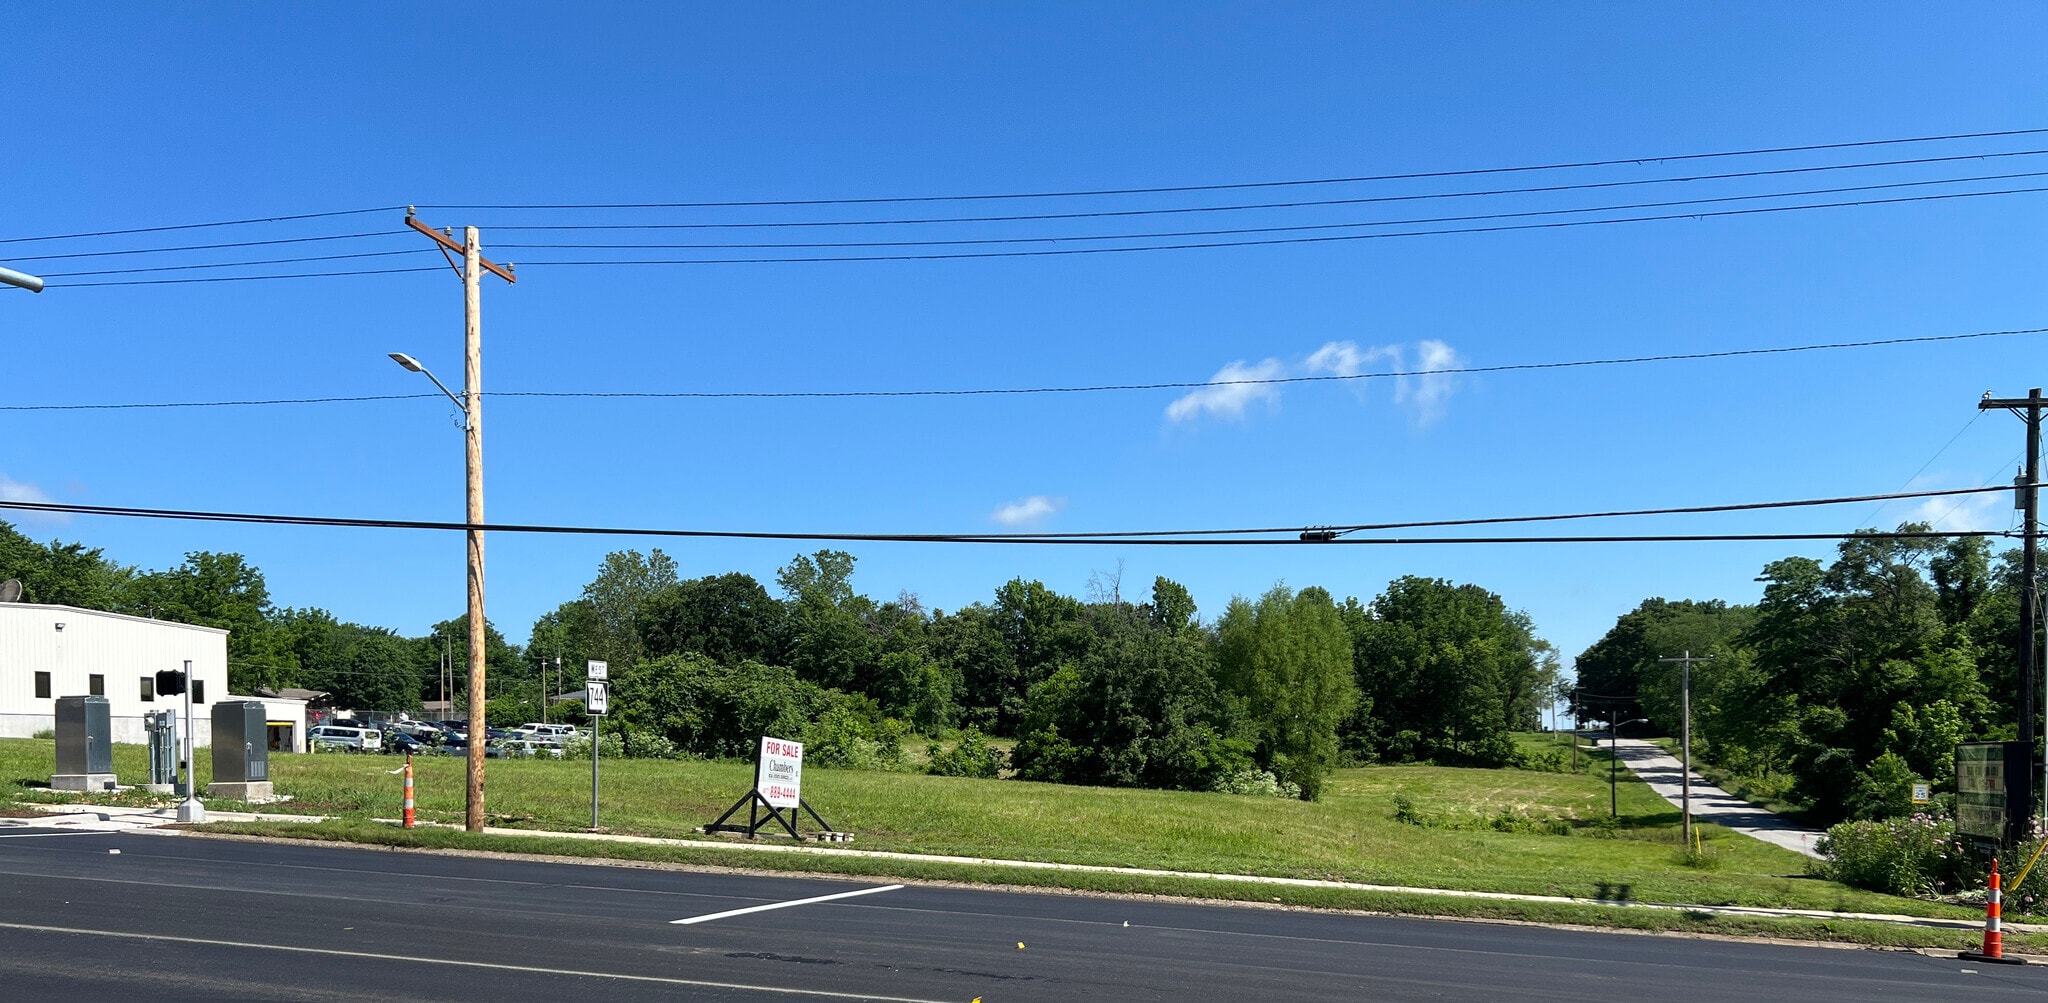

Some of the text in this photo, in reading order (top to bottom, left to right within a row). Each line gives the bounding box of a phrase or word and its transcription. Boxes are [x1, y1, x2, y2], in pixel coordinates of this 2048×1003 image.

[591, 664, 605, 675] WEST
[590, 687, 604, 705] 744
[766, 741, 799, 759] FOR SALE
[769, 759, 794, 774] Chambers
